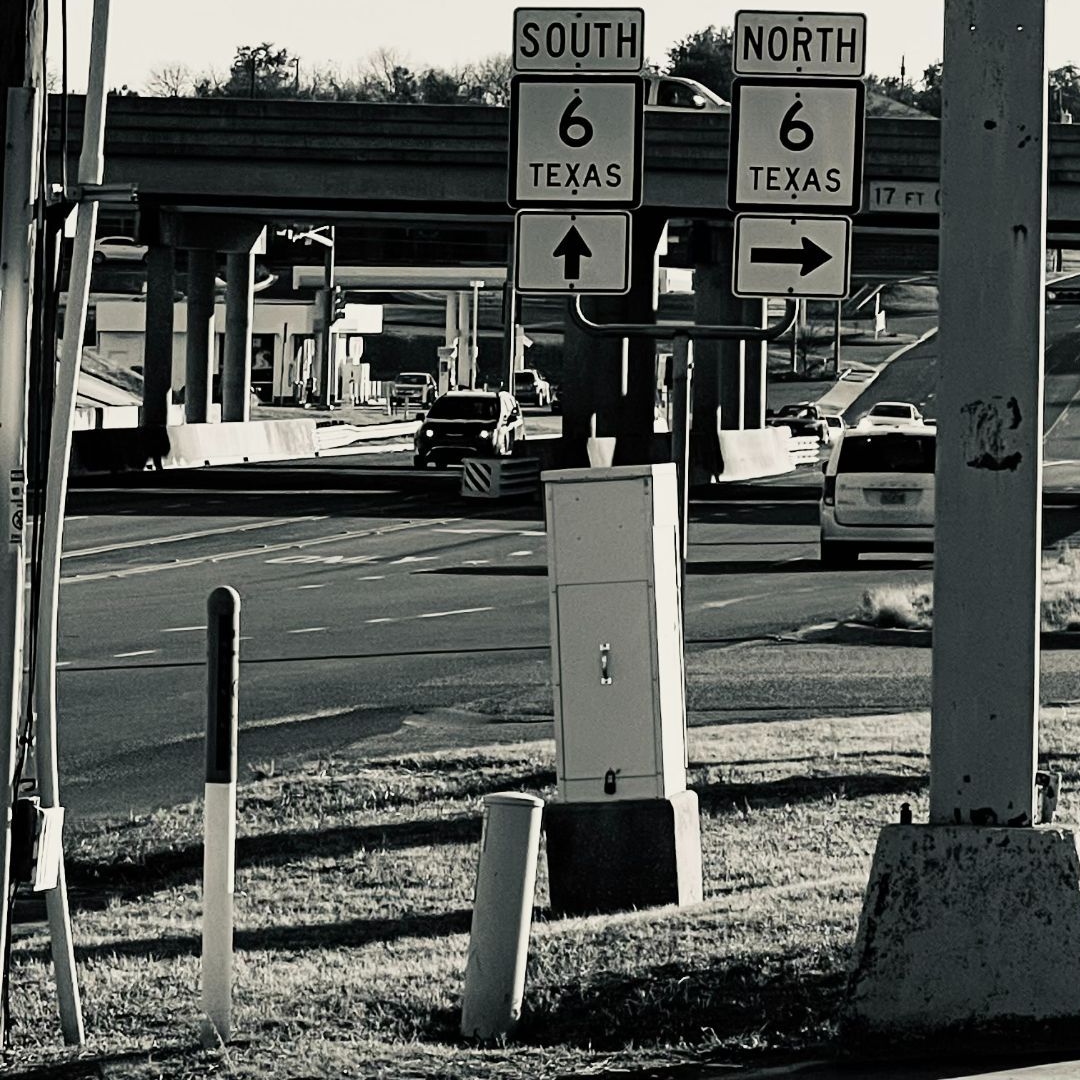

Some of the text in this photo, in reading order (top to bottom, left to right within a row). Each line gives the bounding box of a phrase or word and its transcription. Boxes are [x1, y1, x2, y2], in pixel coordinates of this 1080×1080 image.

[520, 22, 637, 58] SOUTH
[743, 26, 857, 63] NORTH
[558, 95, 594, 148] 6
[779, 100, 814, 152] 6
[529, 163, 622, 188] TEXAS
[749, 166, 841, 193] TEXAS
[875, 187, 896, 206] 17
[905, 191, 925, 206] FT
